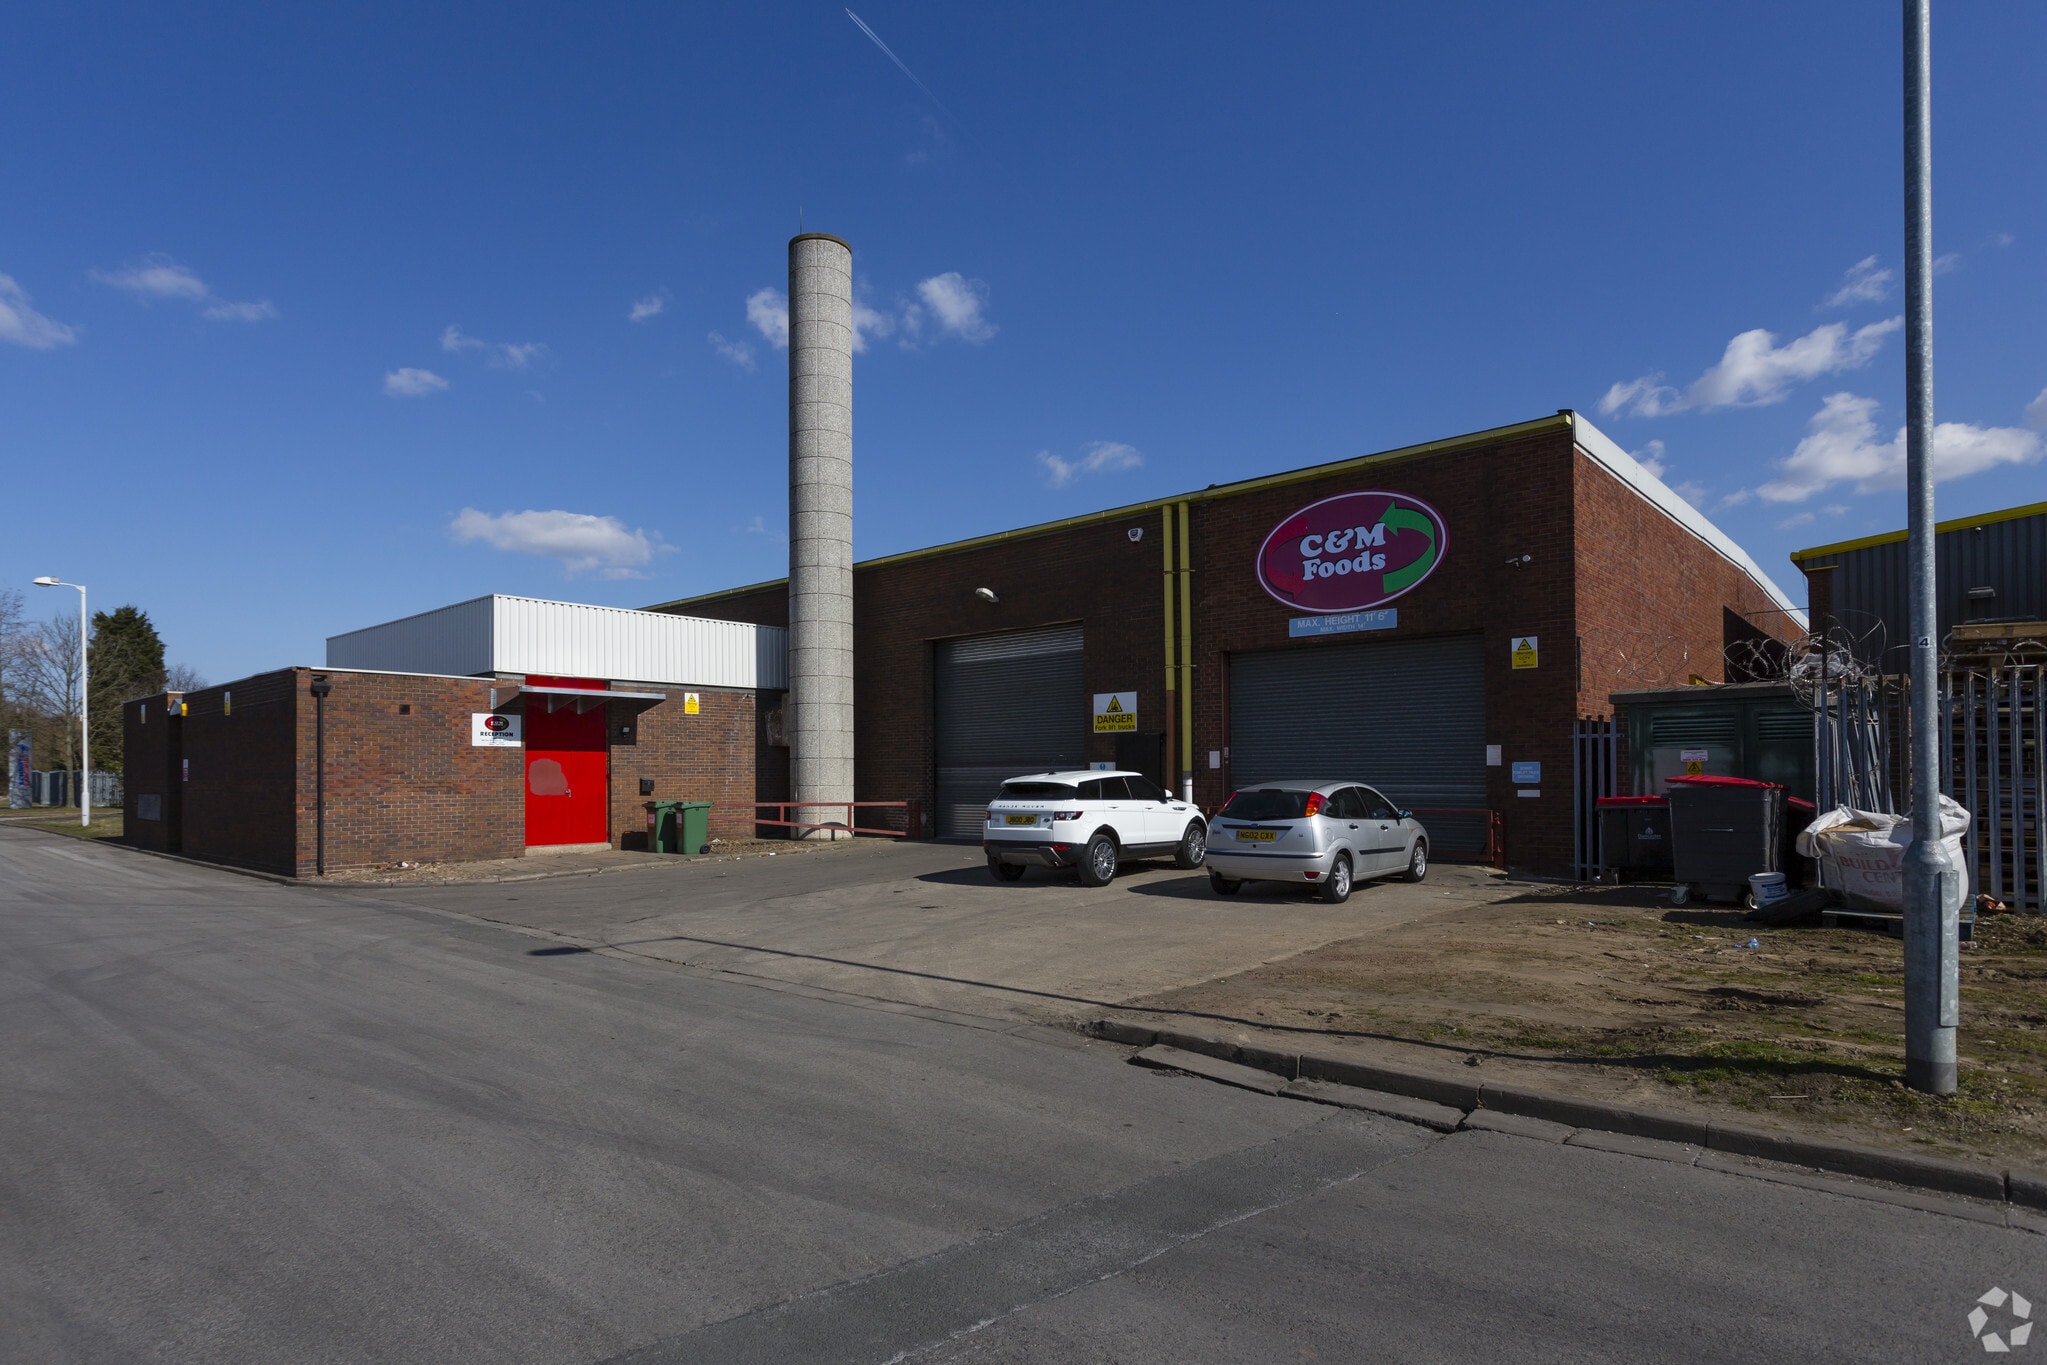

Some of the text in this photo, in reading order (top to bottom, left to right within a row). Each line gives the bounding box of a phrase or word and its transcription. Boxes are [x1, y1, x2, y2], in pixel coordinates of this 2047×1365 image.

[1300, 522, 1386, 558] C&M
[1302, 550, 1386, 581] Foods
[1297, 619, 1320, 629] MAX.
[1324, 615, 1361, 626] HEIGHT
[1919, 637, 1929, 647] 4
[1097, 714, 1132, 723] DANGER
